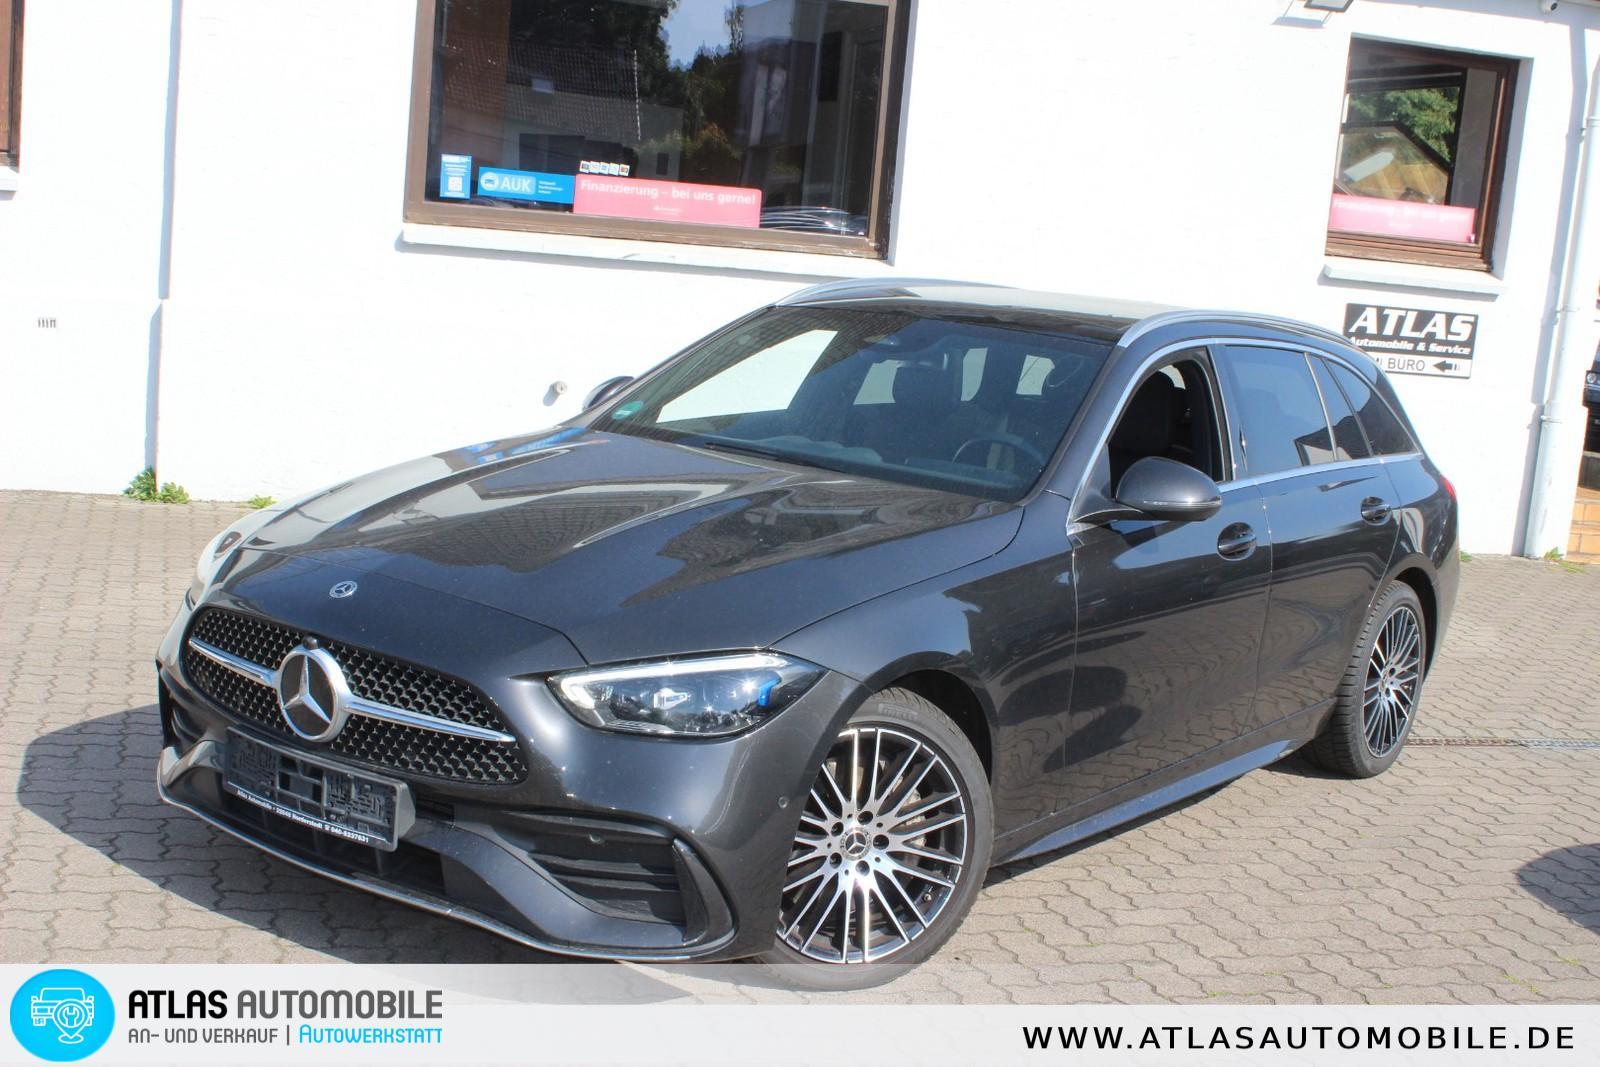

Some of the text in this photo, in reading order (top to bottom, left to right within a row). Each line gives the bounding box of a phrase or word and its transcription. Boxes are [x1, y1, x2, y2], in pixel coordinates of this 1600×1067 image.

[500, 176, 531, 193] AUK
[580, 179, 659, 200] Finanzierung
[671, 188, 690, 200] bei
[693, 191, 715, 202] uns
[717, 192, 756, 206] gerne!
[1348, 305, 1475, 342] ATLAS
[1350, 336, 1471, 355] Automobile & Service
